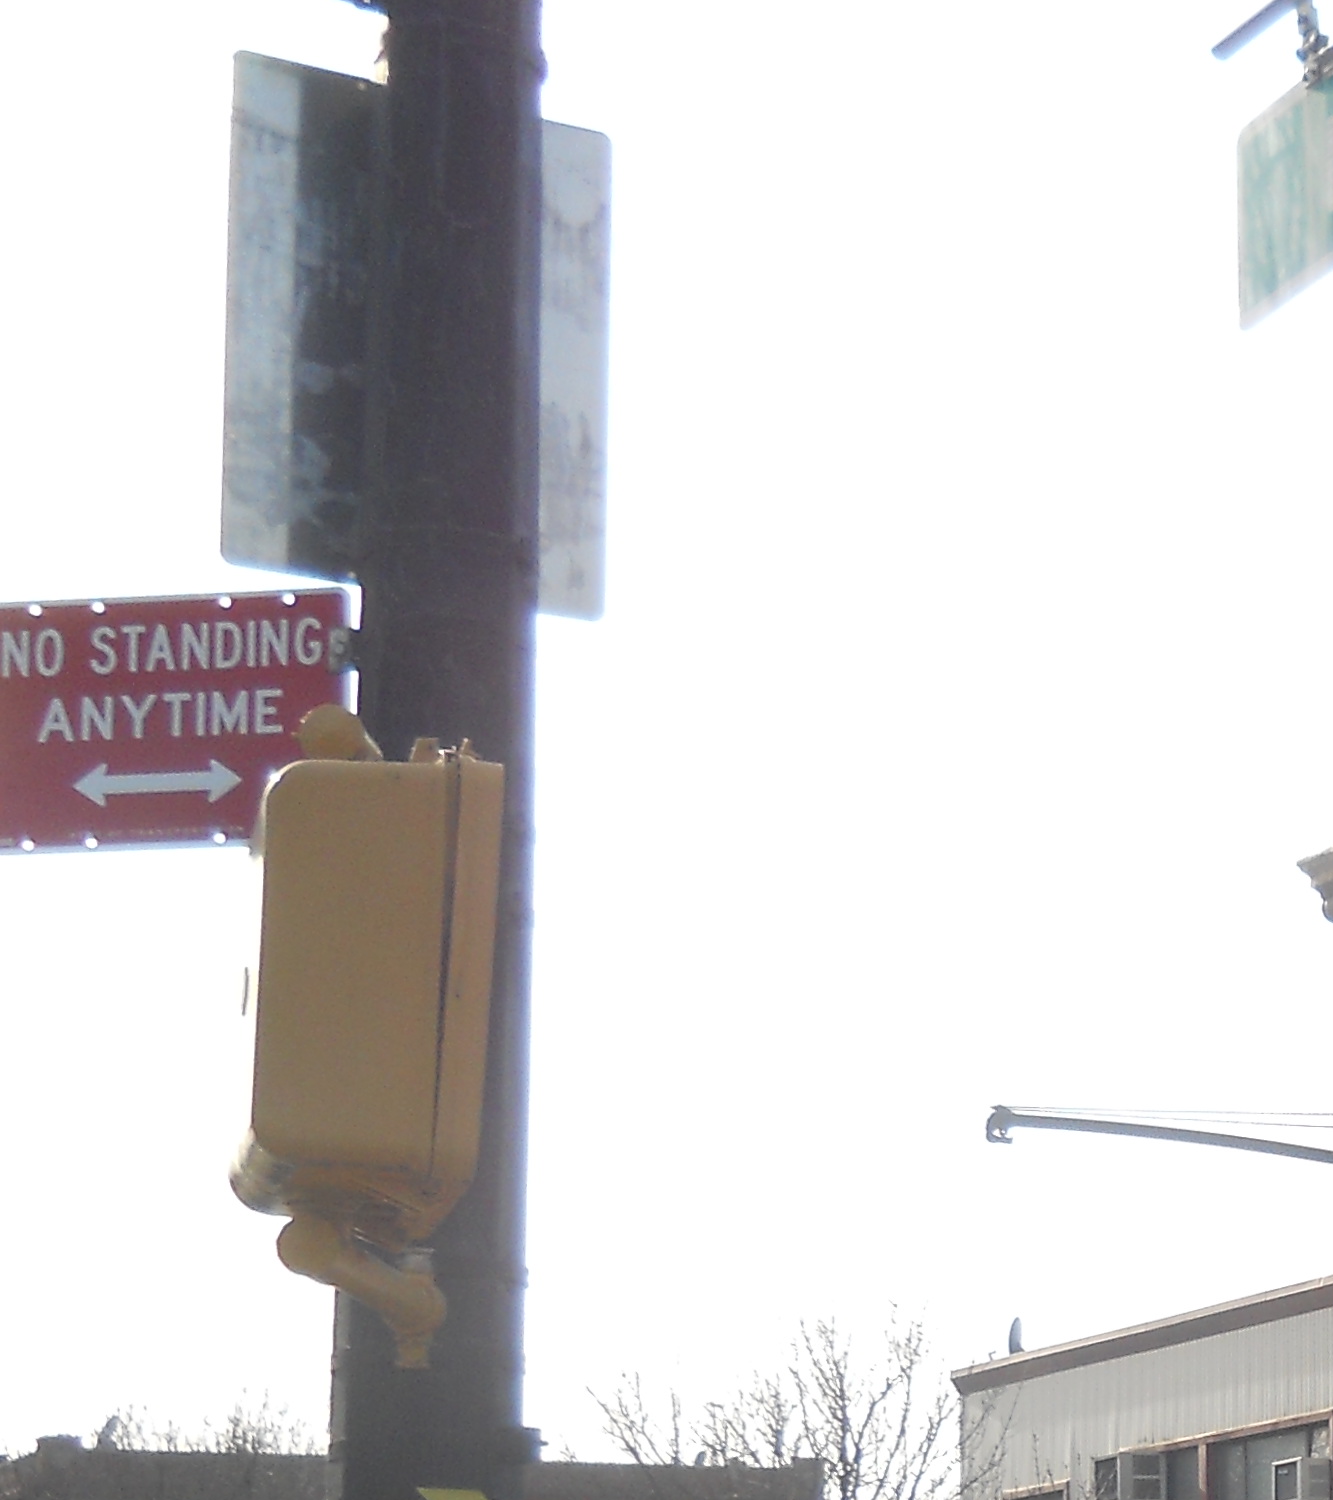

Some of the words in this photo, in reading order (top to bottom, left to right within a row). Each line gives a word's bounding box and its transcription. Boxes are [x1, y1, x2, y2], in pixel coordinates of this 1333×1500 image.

[1, 628, 65, 678] NO
[89, 617, 323, 676] STANDING
[37, 688, 285, 743] ANYTIME
